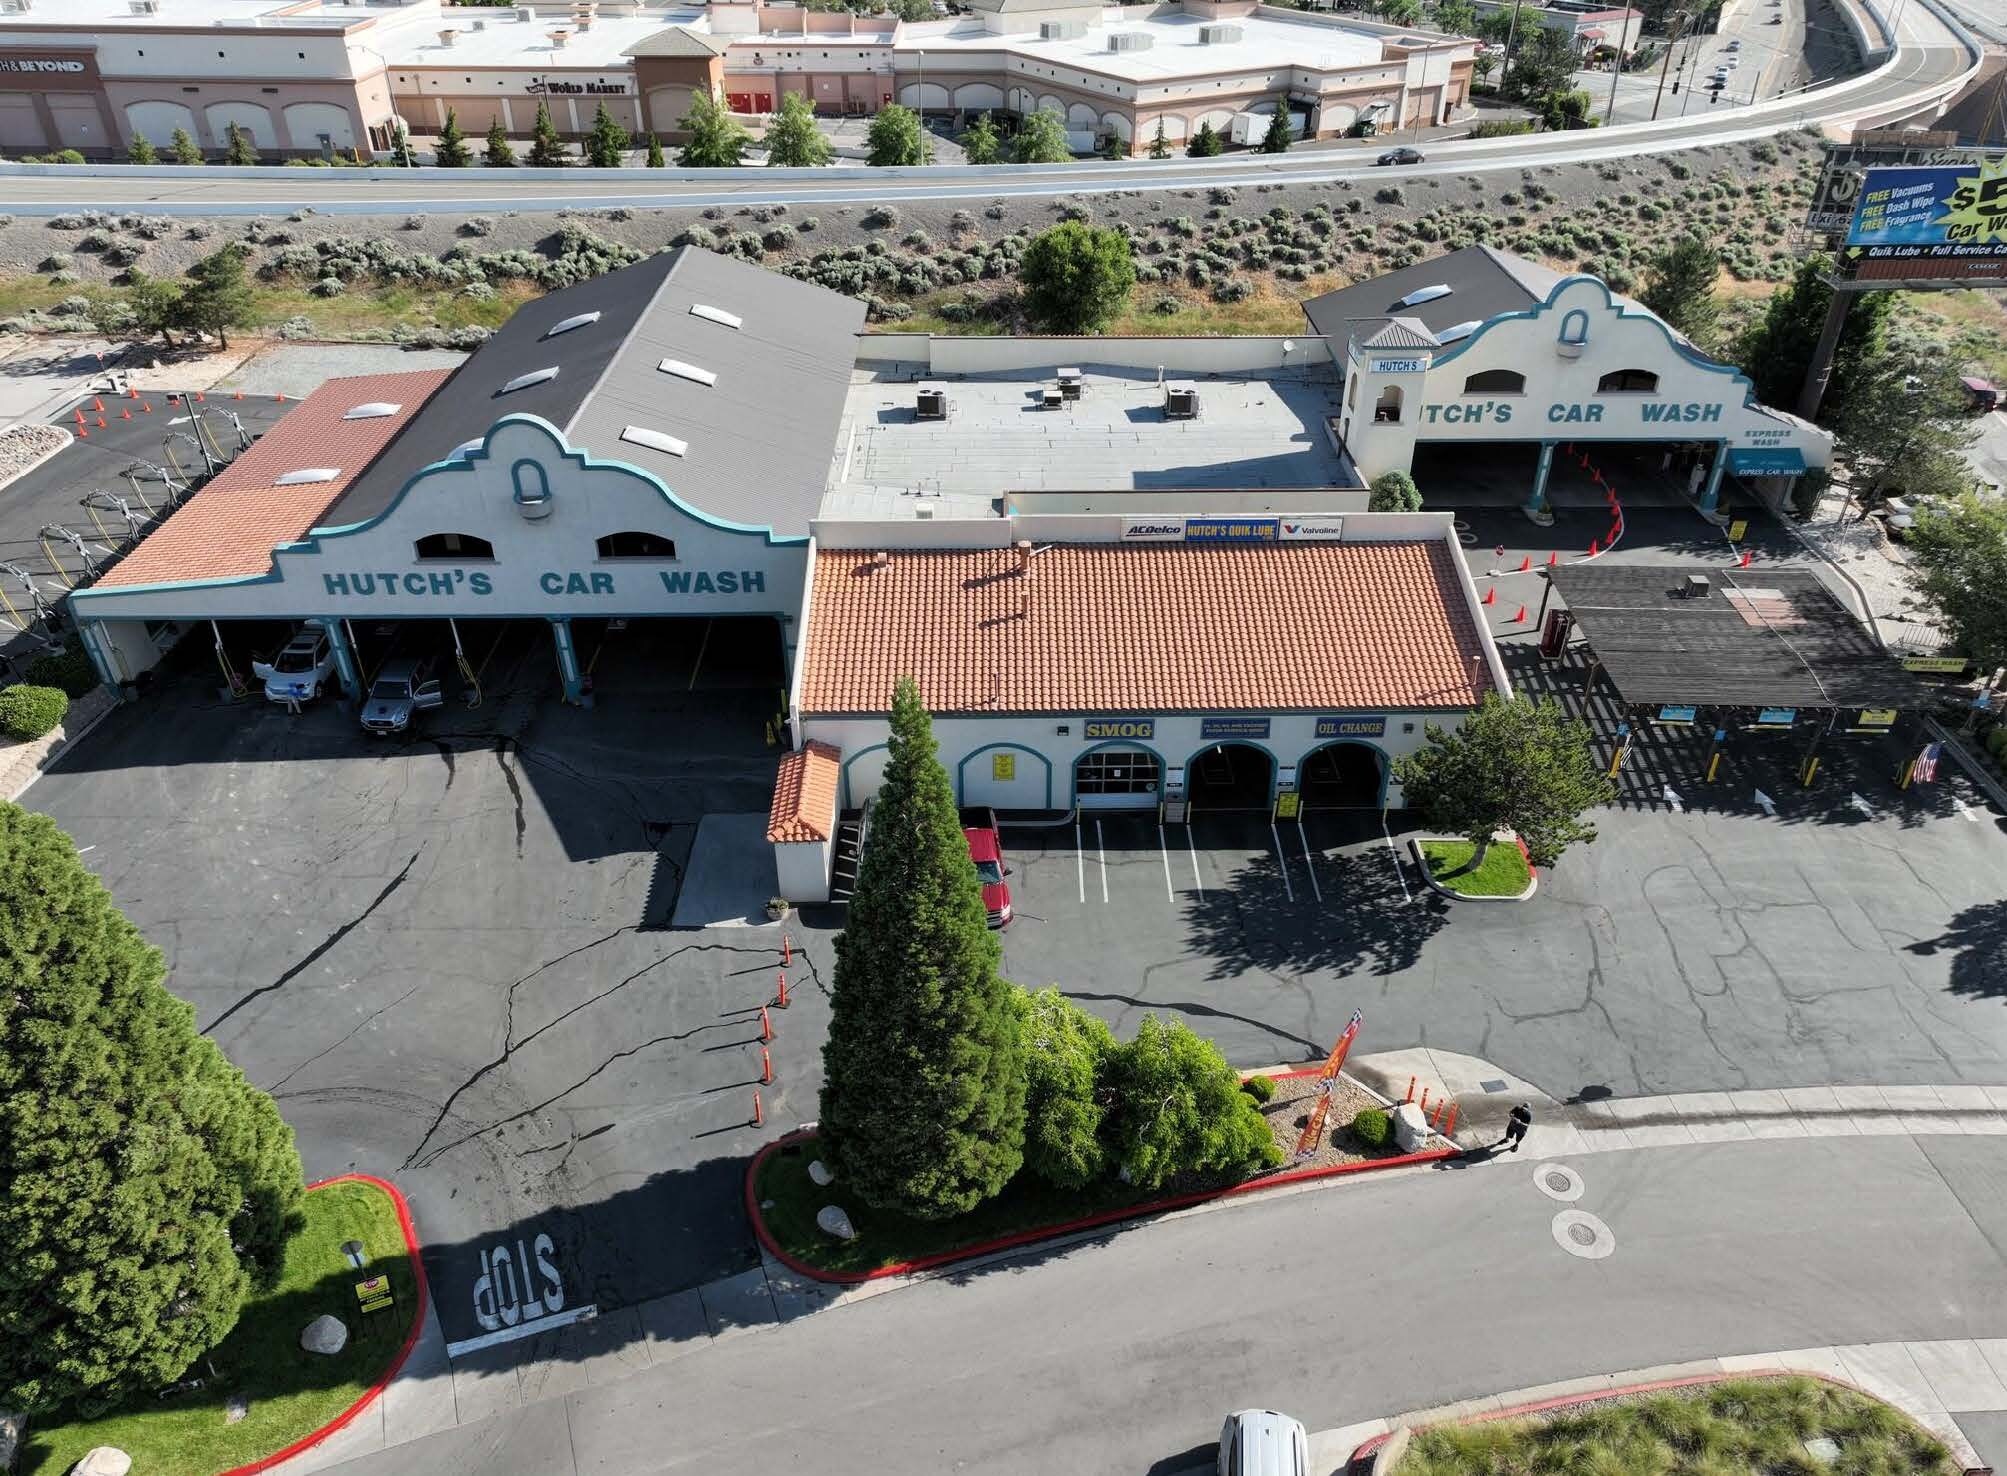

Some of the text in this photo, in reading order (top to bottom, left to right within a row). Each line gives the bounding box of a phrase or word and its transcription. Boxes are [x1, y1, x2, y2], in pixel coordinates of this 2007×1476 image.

[20, 61, 85, 72] BEYOND
[548, 82, 583, 94] WORLD
[586, 82, 625, 94] MARKET
[1866, 182, 1935, 204] FREE Vacuums
[1861, 196, 1935, 218] FREE Dash Wipe
[1859, 211, 1932, 232] FREE Fragrance
[1946, 222, 1983, 240] Car
[1869, 245, 1892, 257] Quik
[1894, 245, 1921, 256] Lube
[1930, 245, 1952, 256] Full
[1952, 245, 1991, 255] Service
[1379, 361, 1417, 371] HUTCH'S
[1420, 401, 1723, 423] TCH'S CAR WASH
[1127, 525, 1181, 535] ACDelco
[1187, 524, 1275, 537] HUTCH'S QUIK LUBE
[1301, 526, 1339, 535] Valvoline
[323, 569, 767, 596] HUTCH'S CAR WASH
[1087, 723, 1152, 738] SMOG
[1319, 722, 1384, 734] OIL CHANGE
[474, 1233, 564, 1331] STOP
